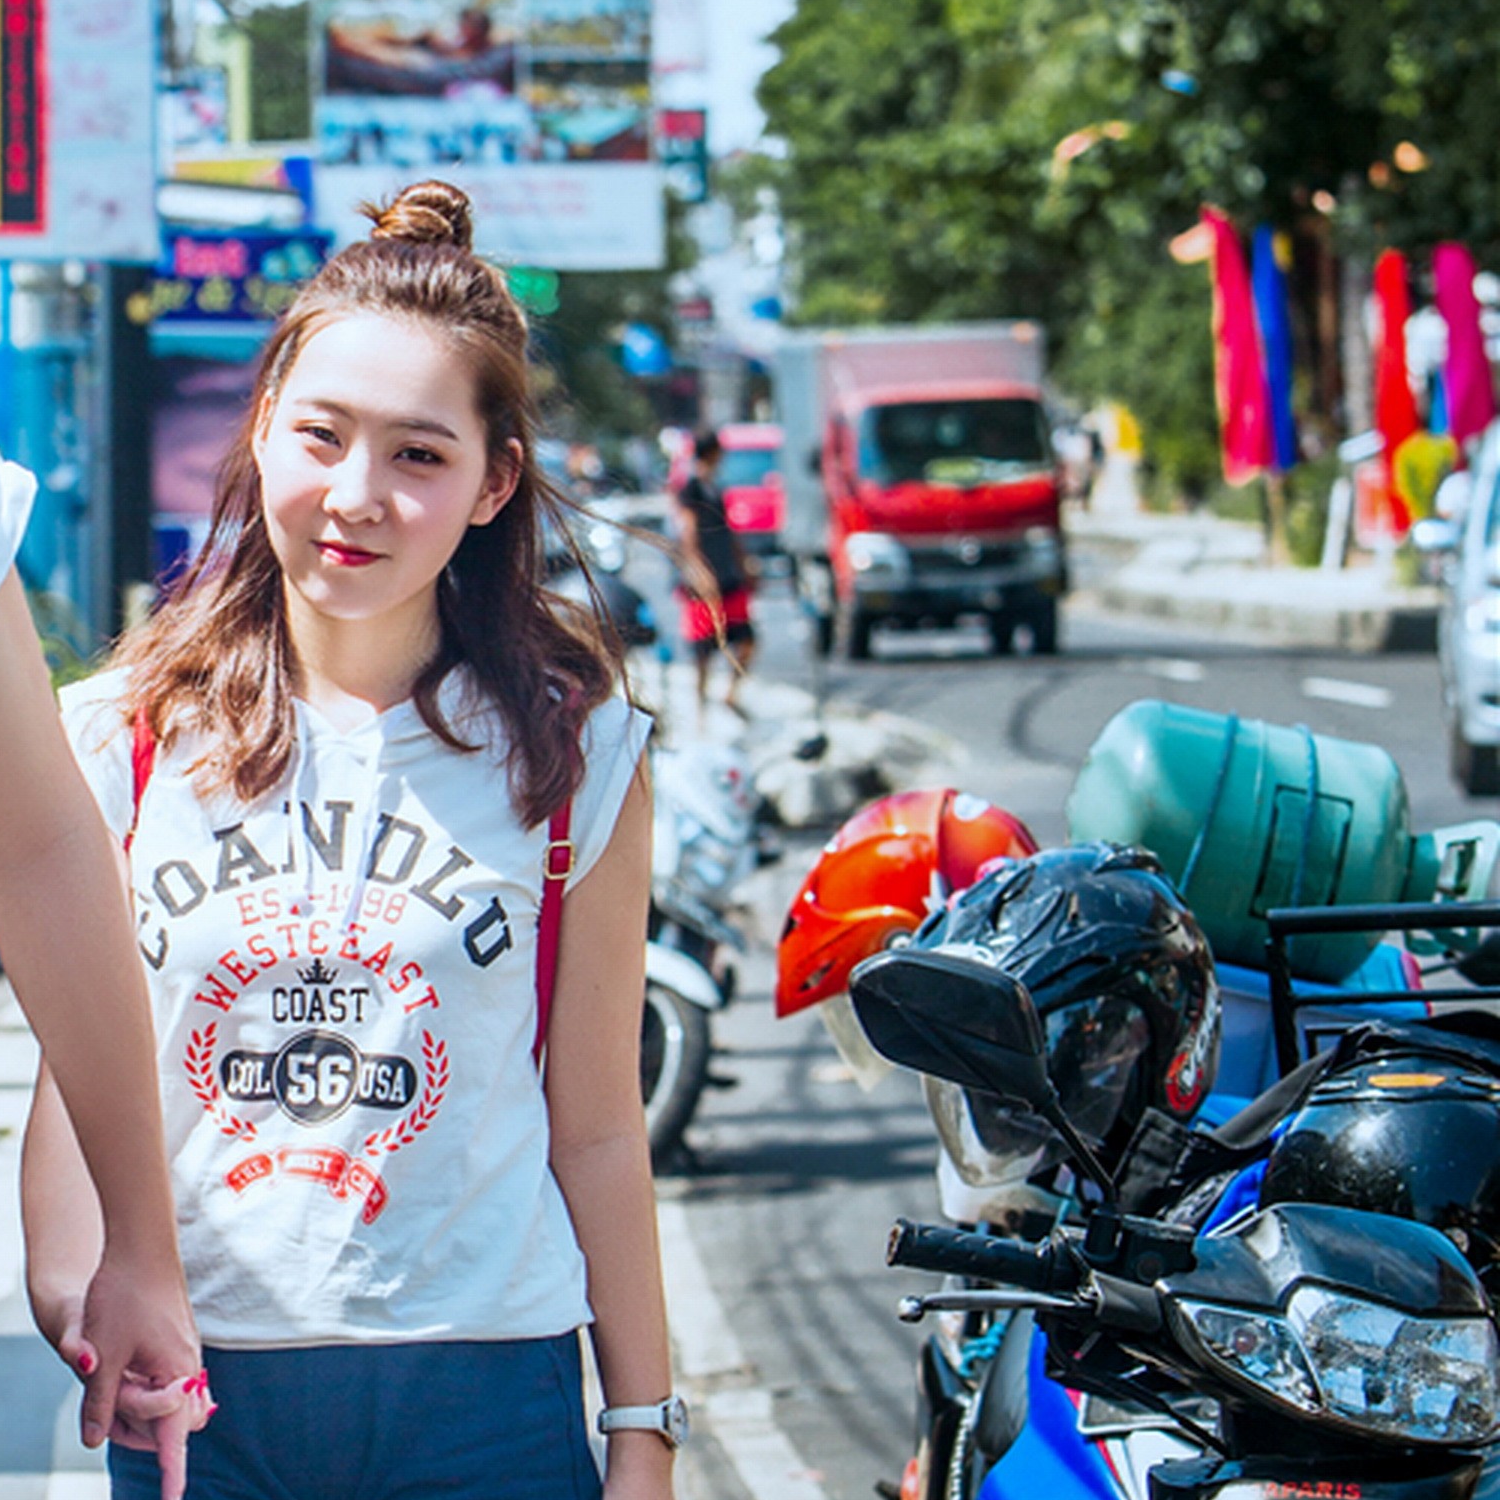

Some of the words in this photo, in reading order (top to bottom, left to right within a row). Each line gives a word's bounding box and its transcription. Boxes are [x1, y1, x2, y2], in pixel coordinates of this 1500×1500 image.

[271, 986, 370, 1024] COAST
[226, 1057, 273, 1096] COL
[286, 1052, 352, 1106] 56
[358, 1062, 408, 1103] USA
